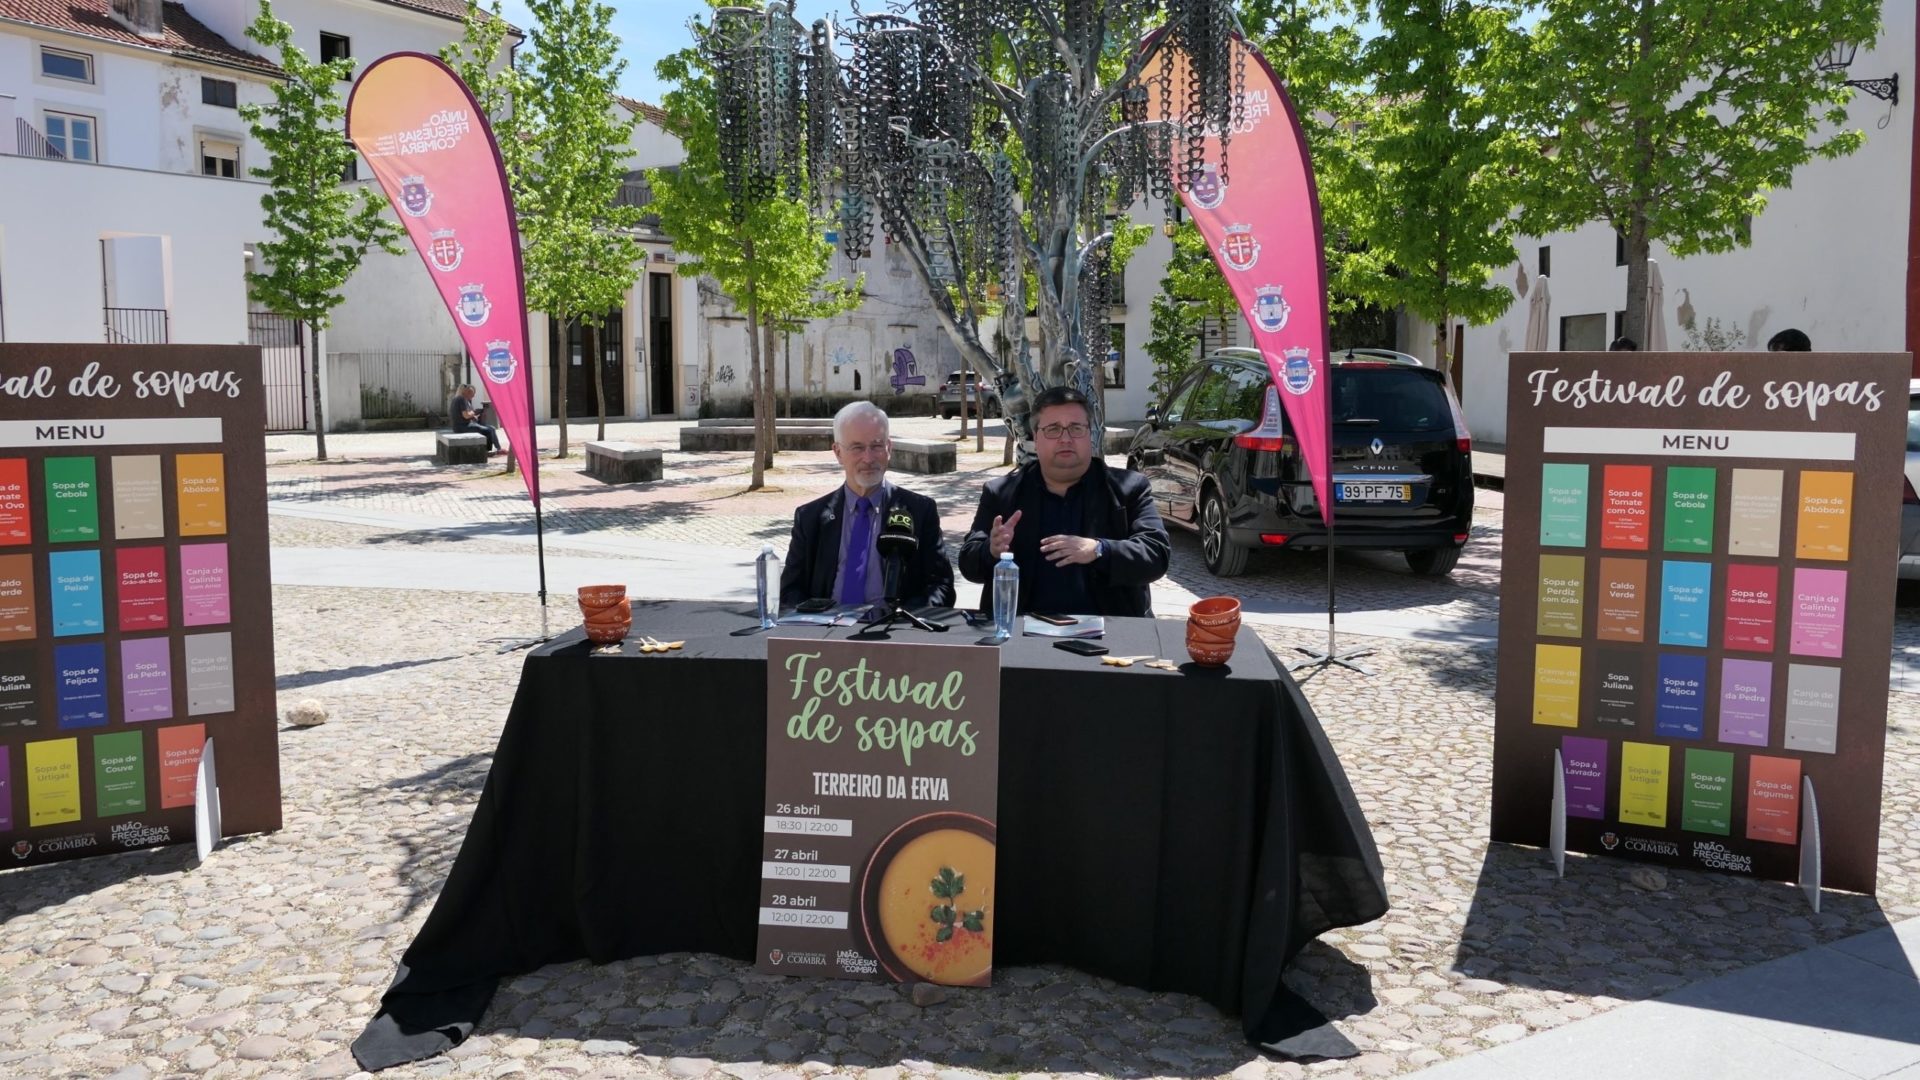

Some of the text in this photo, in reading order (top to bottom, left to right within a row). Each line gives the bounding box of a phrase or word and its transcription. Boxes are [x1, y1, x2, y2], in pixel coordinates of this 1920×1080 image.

[68, 361, 121, 399] de
[132, 369, 242, 408] sopas
[1528, 367, 1884, 421] Festival de sopas
[36, 425, 105, 440] MENU
[1662, 434, 1729, 451] MENU
[52, 481, 90, 490] Sopa de
[182, 476, 217, 485] Sopa de
[55, 490, 87, 498] Cebola
[183, 485, 219, 493] Abóbora
[1548, 487, 1570, 495] Sopa
[1608, 489, 1643, 497] Sopa de
[1672, 491, 1708, 500] Sopa de
[1804, 496, 1843, 505] Sopa de
[1610, 498, 1643, 506] Tomate
[1674, 500, 1706, 509] Cebola
[1627, 507, 1645, 515] Ovo
[1804, 505, 1845, 514] Abóbora
[122, 572, 145, 580] Sopa
[186, 568, 210, 576] Canja
[57, 576, 80, 584] Sopa
[188, 576, 222, 584] Galinha
[1543, 577, 1579, 587] Sopa de
[1610, 581, 1635, 590] Caldo
[1668, 585, 1703, 594] Sopa de
[1546, 587, 1575, 596] Perdiz
[1609, 591, 1635, 599] Verde
[1731, 589, 1769, 598] Sopa de
[1560, 596, 1579, 604] Grão
[1673, 594, 1697, 603] Peixe
[1798, 594, 1840, 604] Canja de
[1800, 603, 1836, 612] Galinha
[62, 669, 85, 677] Sopa
[127, 670, 167, 680] da Pedra
[1607, 673, 1629, 682] Sopa
[1, 674, 25, 683] Sopa
[65, 676, 98, 686] Feijoca
[785, 651, 966, 711] Festival
[1663, 677, 1699, 687] Sopa de
[1602, 681, 1634, 691] Juliana
[1665, 686, 1696, 696] Feijoca
[1734, 684, 1757, 693] Sopa
[1725, 692, 1765, 703] da Pedra
[1793, 689, 1834, 699] Canja de
[1791, 698, 1834, 709] Bacalhau
[786, 696, 980, 766] de sopas
[188, 747, 200, 755] de
[101, 755, 137, 766] Sopa de
[1570, 760, 1591, 768] Sopa
[34, 763, 72, 774] Sopa de
[105, 764, 133, 774] Couve
[1565, 768, 1601, 777] Lavrador
[1628, 766, 1662, 775] Sopa de
[37, 772, 70, 782] Urtigas
[1630, 775, 1660, 785] Urtigas
[1690, 772, 1727, 783] Sopa de
[812, 771, 949, 801] TERREIRO DA ERVA
[1694, 782, 1722, 792] Couve
[1755, 780, 1793, 791] Sopa de
[1753, 789, 1794, 800] Legumes
[776, 803, 820, 816] 26 abril
[111, 821, 142, 833] UNIÃO
[776, 820, 838, 833] 18:30 22:00
[111, 826, 170, 841] FREGUESIAS
[39, 837, 97, 853] COIMBRA
[124, 834, 171, 847] COIMBRA
[1624, 840, 1679, 857] COIMBRA
[1693, 841, 1724, 853] UNIÃO
[774, 848, 818, 861] 27 abril
[1693, 849, 1751, 865] FREGUESIAS
[1705, 859, 1752, 873] COIMBRA
[774, 865, 836, 879] 12:00 22:00
[772, 894, 817, 908] 28 abril
[771, 911, 834, 925] 12:00 22:00
[836, 949, 859, 958] UNIÃO
[787, 955, 826, 966] COIMBRA
[836, 957, 878, 967] FREGUESIAS
[844, 965, 878, 974] COIMBRA
